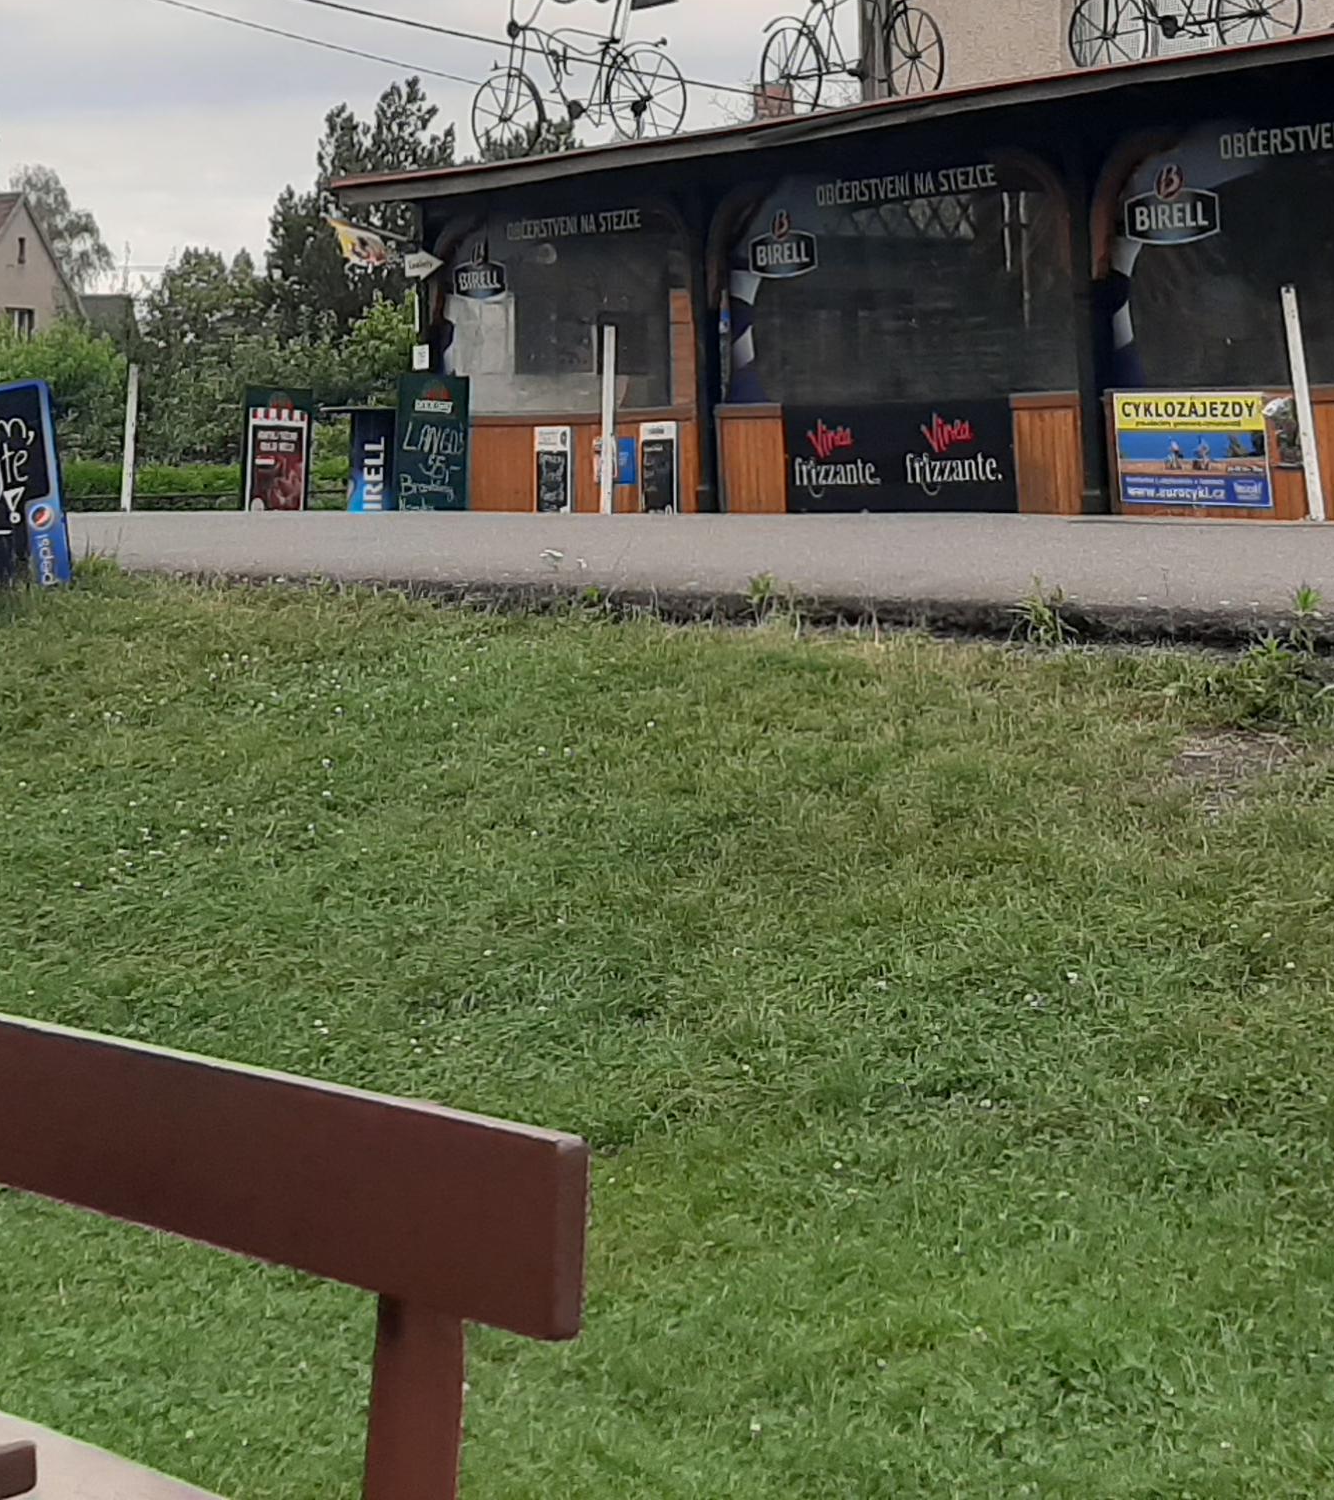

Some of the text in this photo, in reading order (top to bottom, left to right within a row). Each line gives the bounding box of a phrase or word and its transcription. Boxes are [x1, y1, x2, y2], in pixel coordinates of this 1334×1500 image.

[817, 163, 997, 206] OBČERSTVENÍ NA STEZCE
[580, 215, 596, 234] NA
[599, 209, 641, 232] STEZCE
[1135, 201, 1209, 231] BIRELL
[756, 240, 809, 266] BIRELL
[458, 269, 501, 292] BIRELL
[1121, 394, 1255, 418] CYKLOZÁJEZDY
[806, 418, 854, 458] Vinea
[920, 412, 974, 453] Vinea
[362, 436, 385, 510] IRELL
